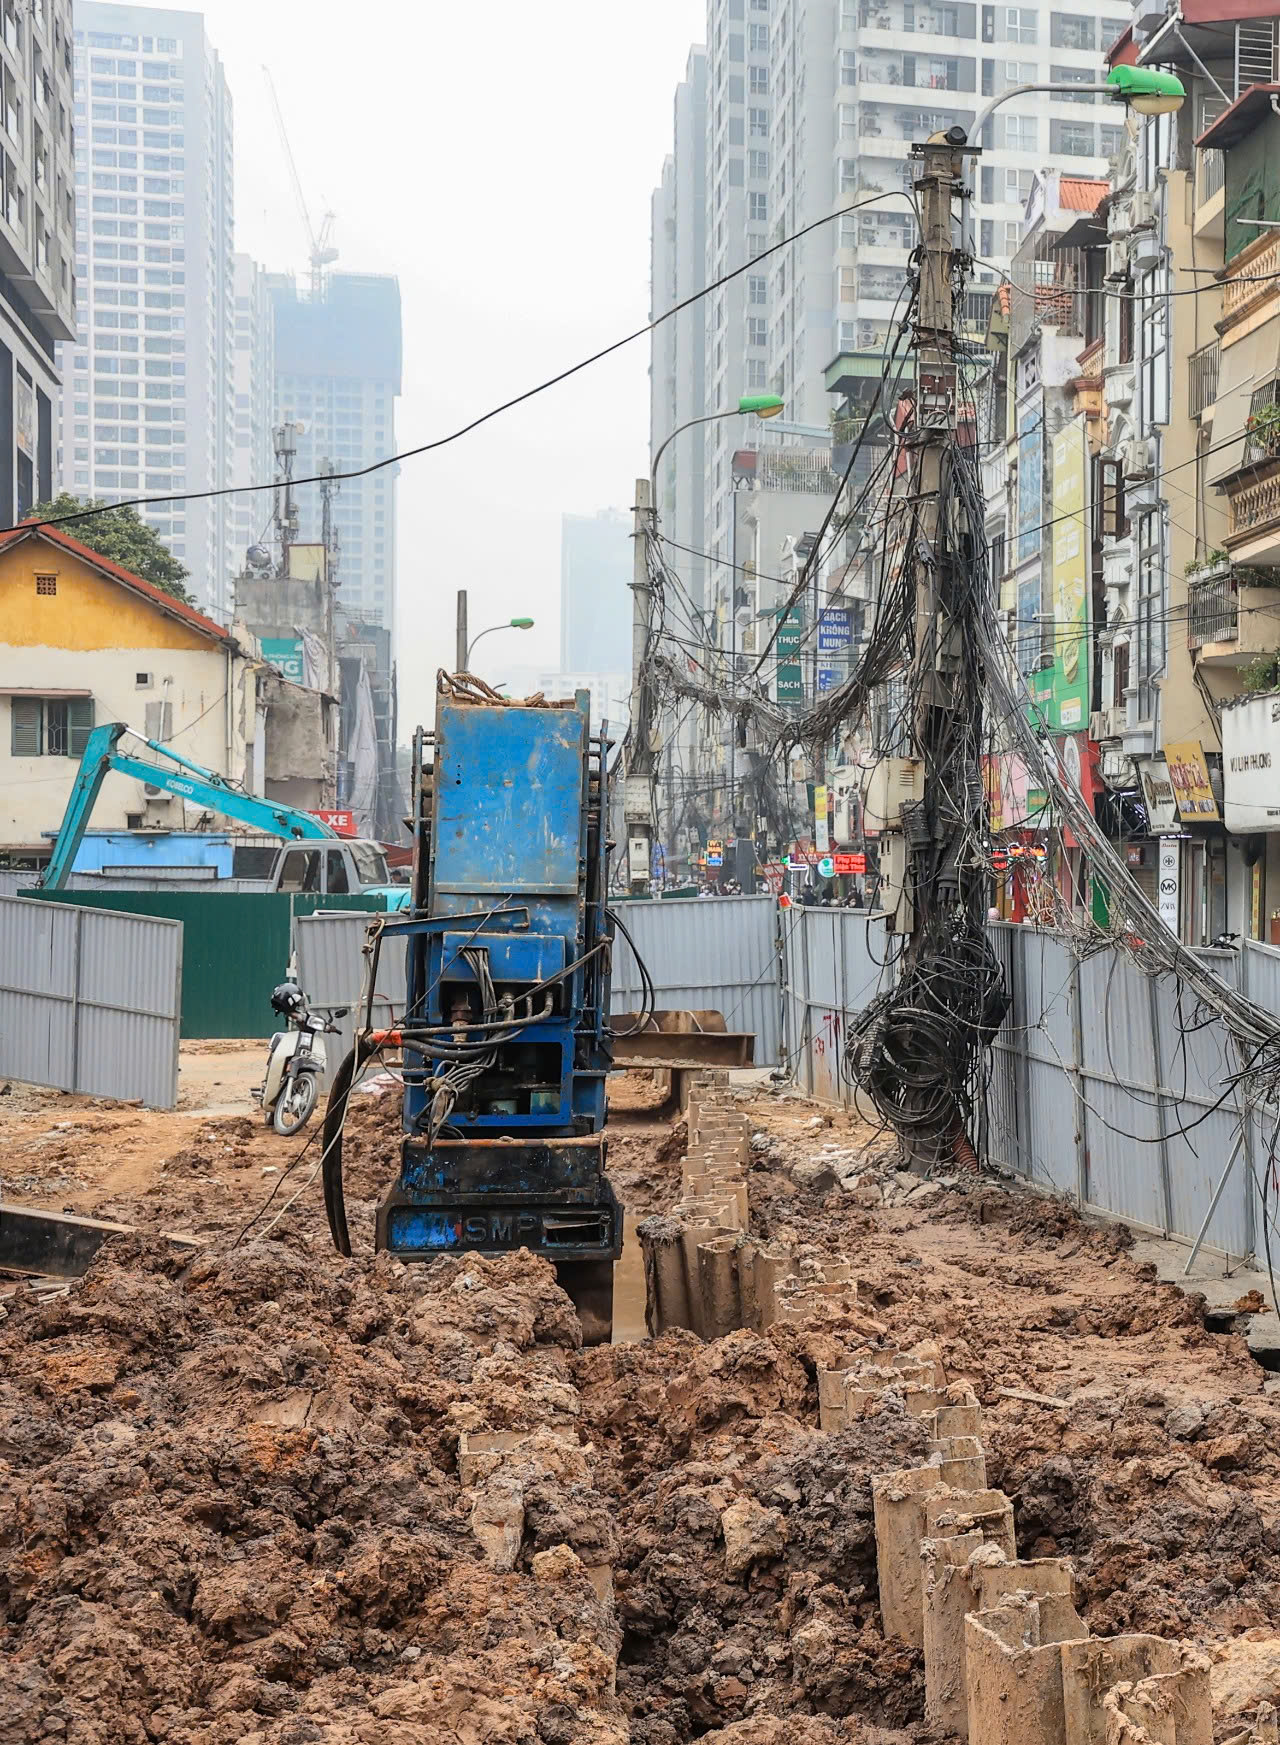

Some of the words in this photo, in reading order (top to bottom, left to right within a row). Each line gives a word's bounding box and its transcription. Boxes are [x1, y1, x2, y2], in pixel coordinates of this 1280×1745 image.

[821, 624, 849, 635] KHÔNG
[778, 681, 800, 690] SẠCH
[327, 815, 348, 826] XE
